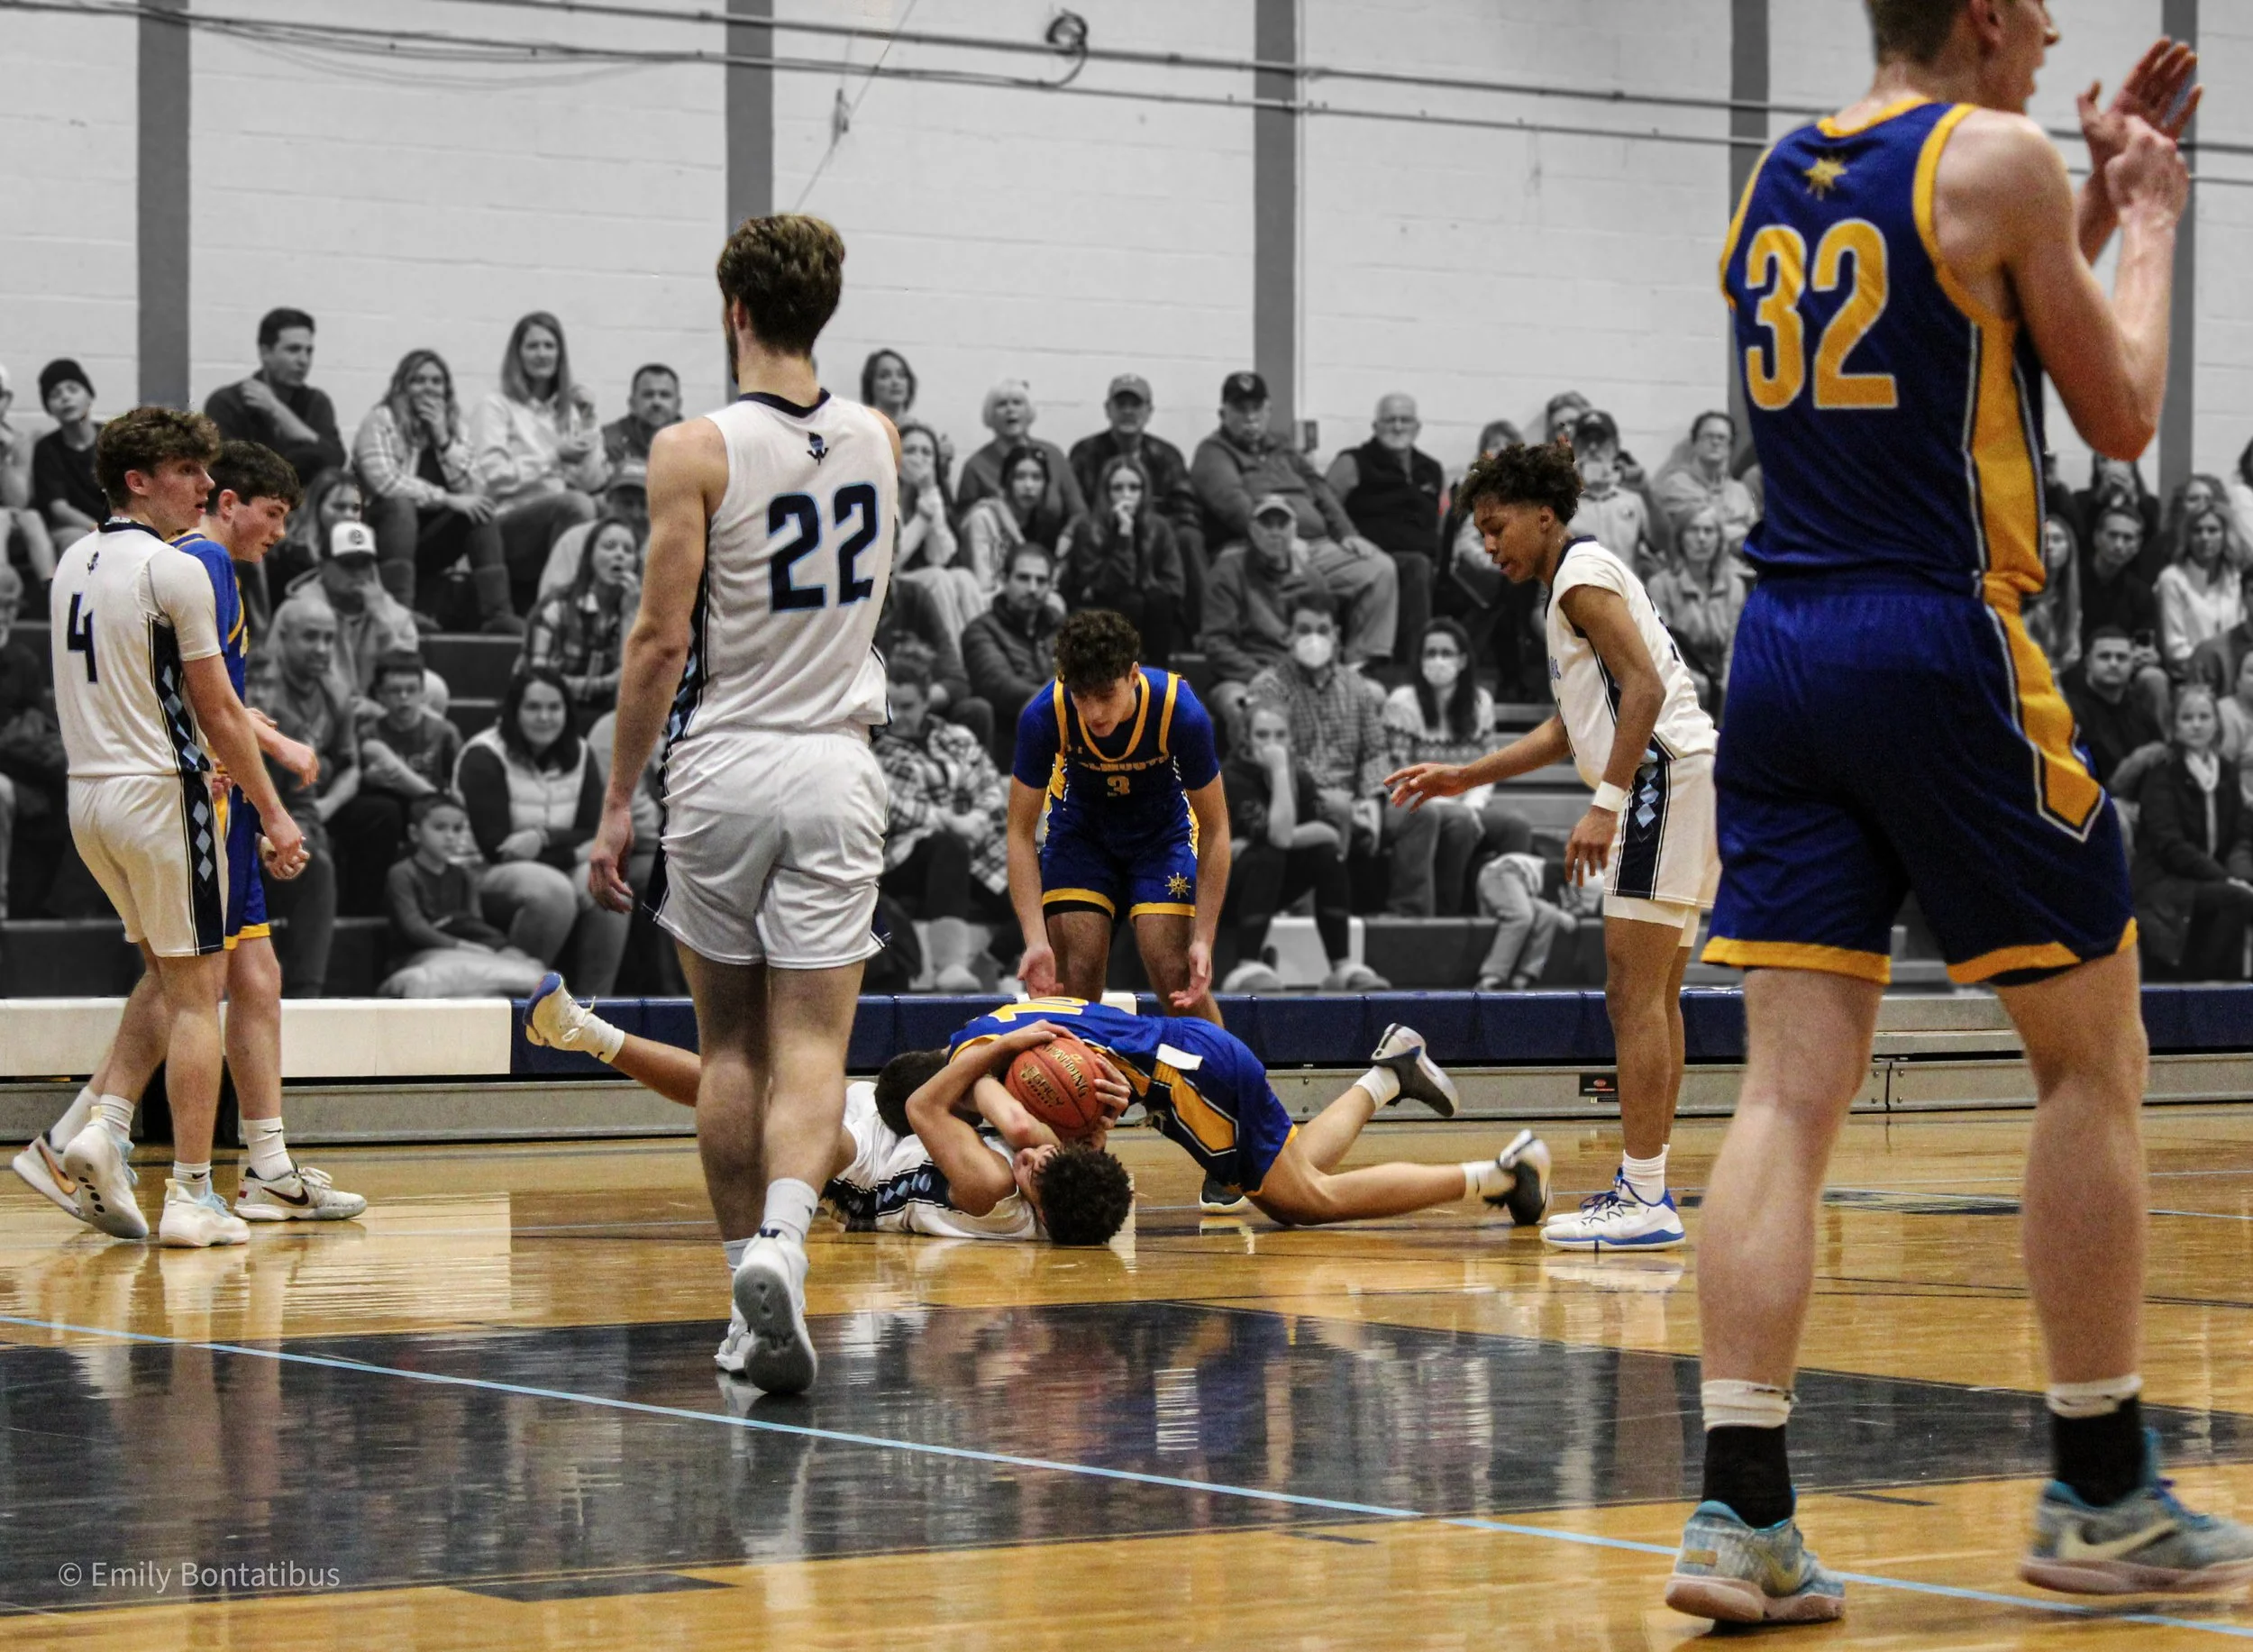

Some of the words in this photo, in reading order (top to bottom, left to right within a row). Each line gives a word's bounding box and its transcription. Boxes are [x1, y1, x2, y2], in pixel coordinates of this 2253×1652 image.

[1745, 217, 1900, 410] 32
[766, 480, 880, 615] 22
[67, 591, 98, 685] 4
[1107, 774, 1131, 798] 3
[1044, 1044, 1090, 1099] PALDING
